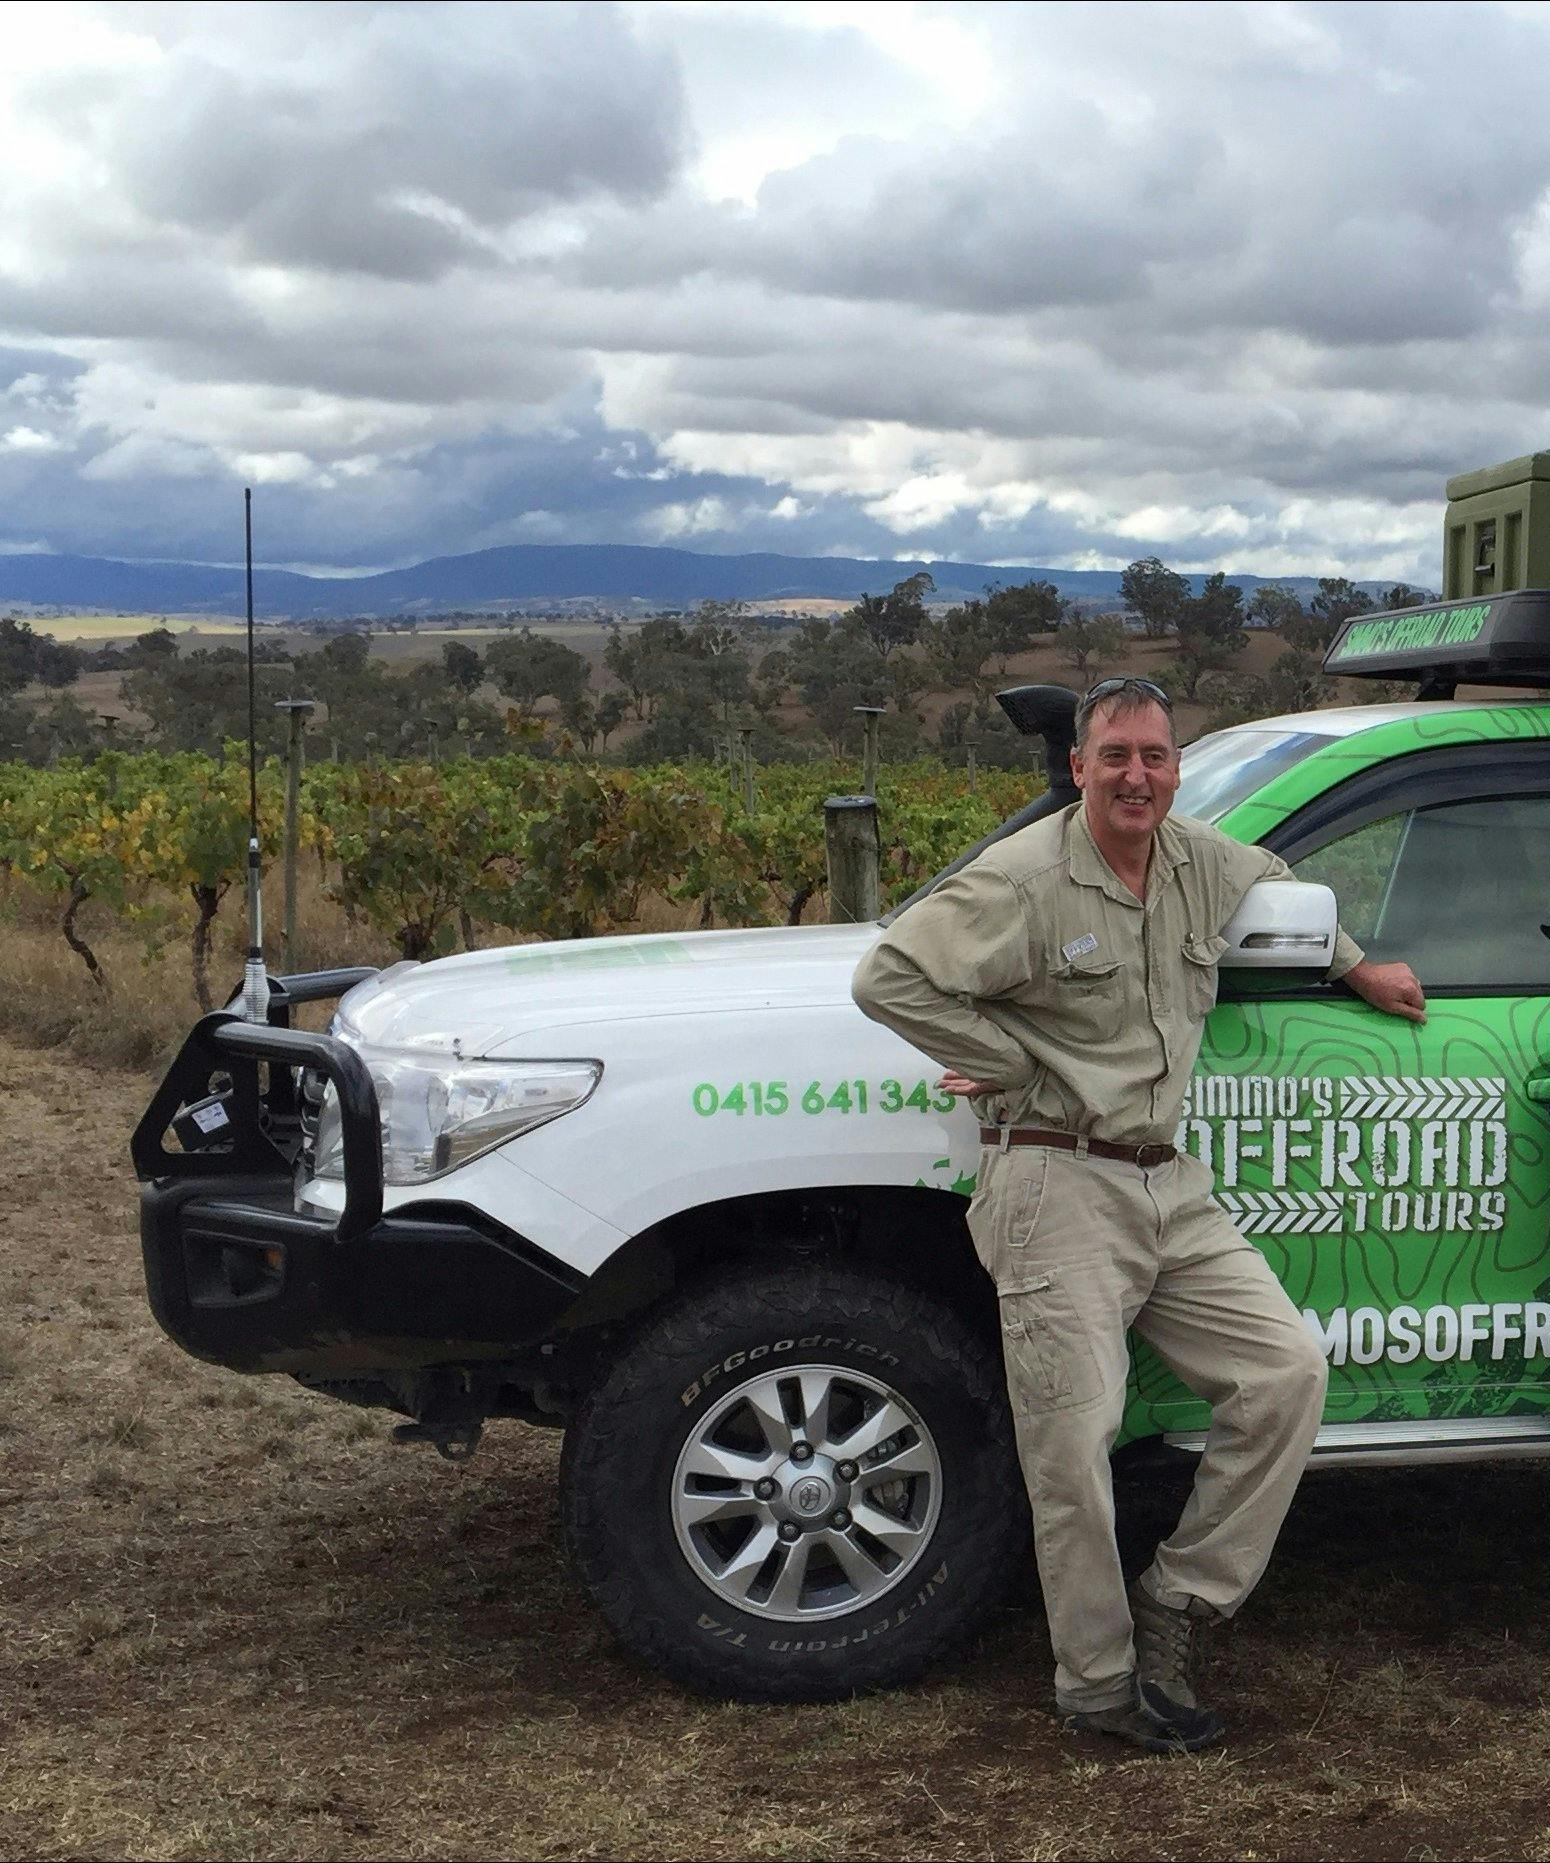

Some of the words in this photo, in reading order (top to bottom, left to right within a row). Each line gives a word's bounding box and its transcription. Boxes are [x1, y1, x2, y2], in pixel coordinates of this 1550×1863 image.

[1438, 604, 1491, 645] TOURS
[691, 1081, 790, 1117] 0415
[801, 1079, 869, 1115] 641
[1173, 1119, 1507, 1188] OFFROAD
[1348, 1191, 1506, 1232] TOURS
[680, 1334, 901, 1408] BFGoodrich
